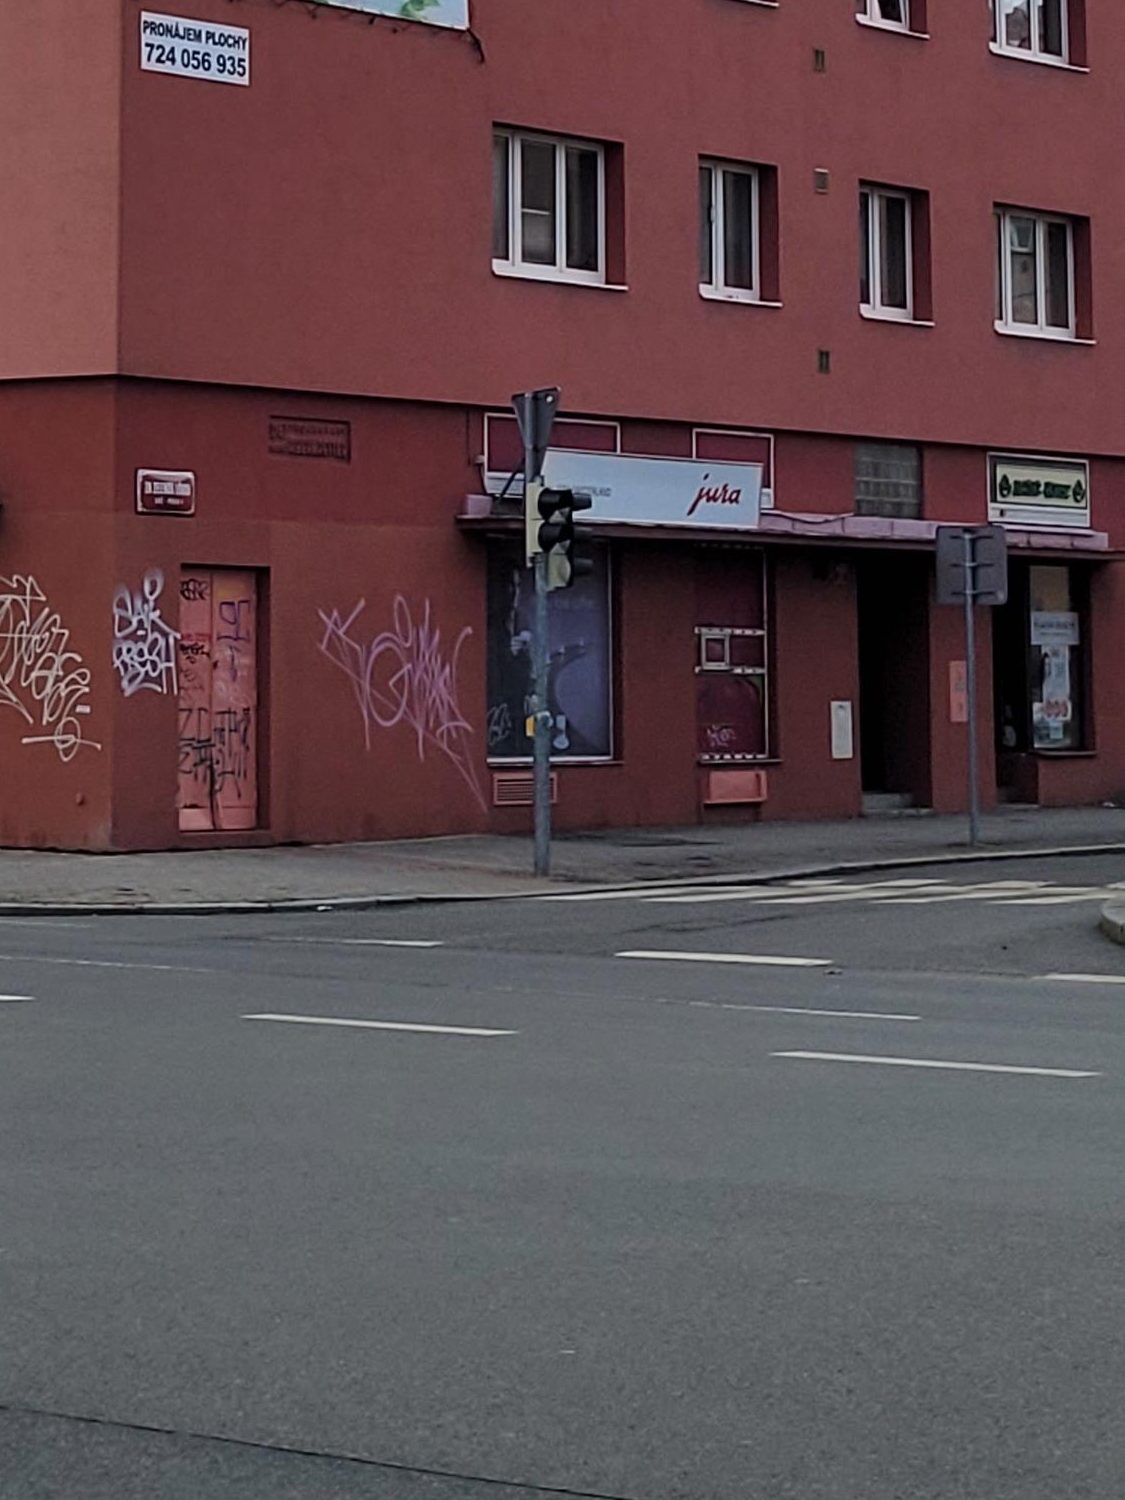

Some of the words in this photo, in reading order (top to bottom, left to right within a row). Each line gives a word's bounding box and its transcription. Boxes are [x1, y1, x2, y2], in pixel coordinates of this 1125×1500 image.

[205, 29, 248, 51] PLOCHY
[144, 42, 177, 66] 724
[181, 48, 212, 72] 056
[216, 54, 247, 78] 935
[686, 473, 742, 517] jura
